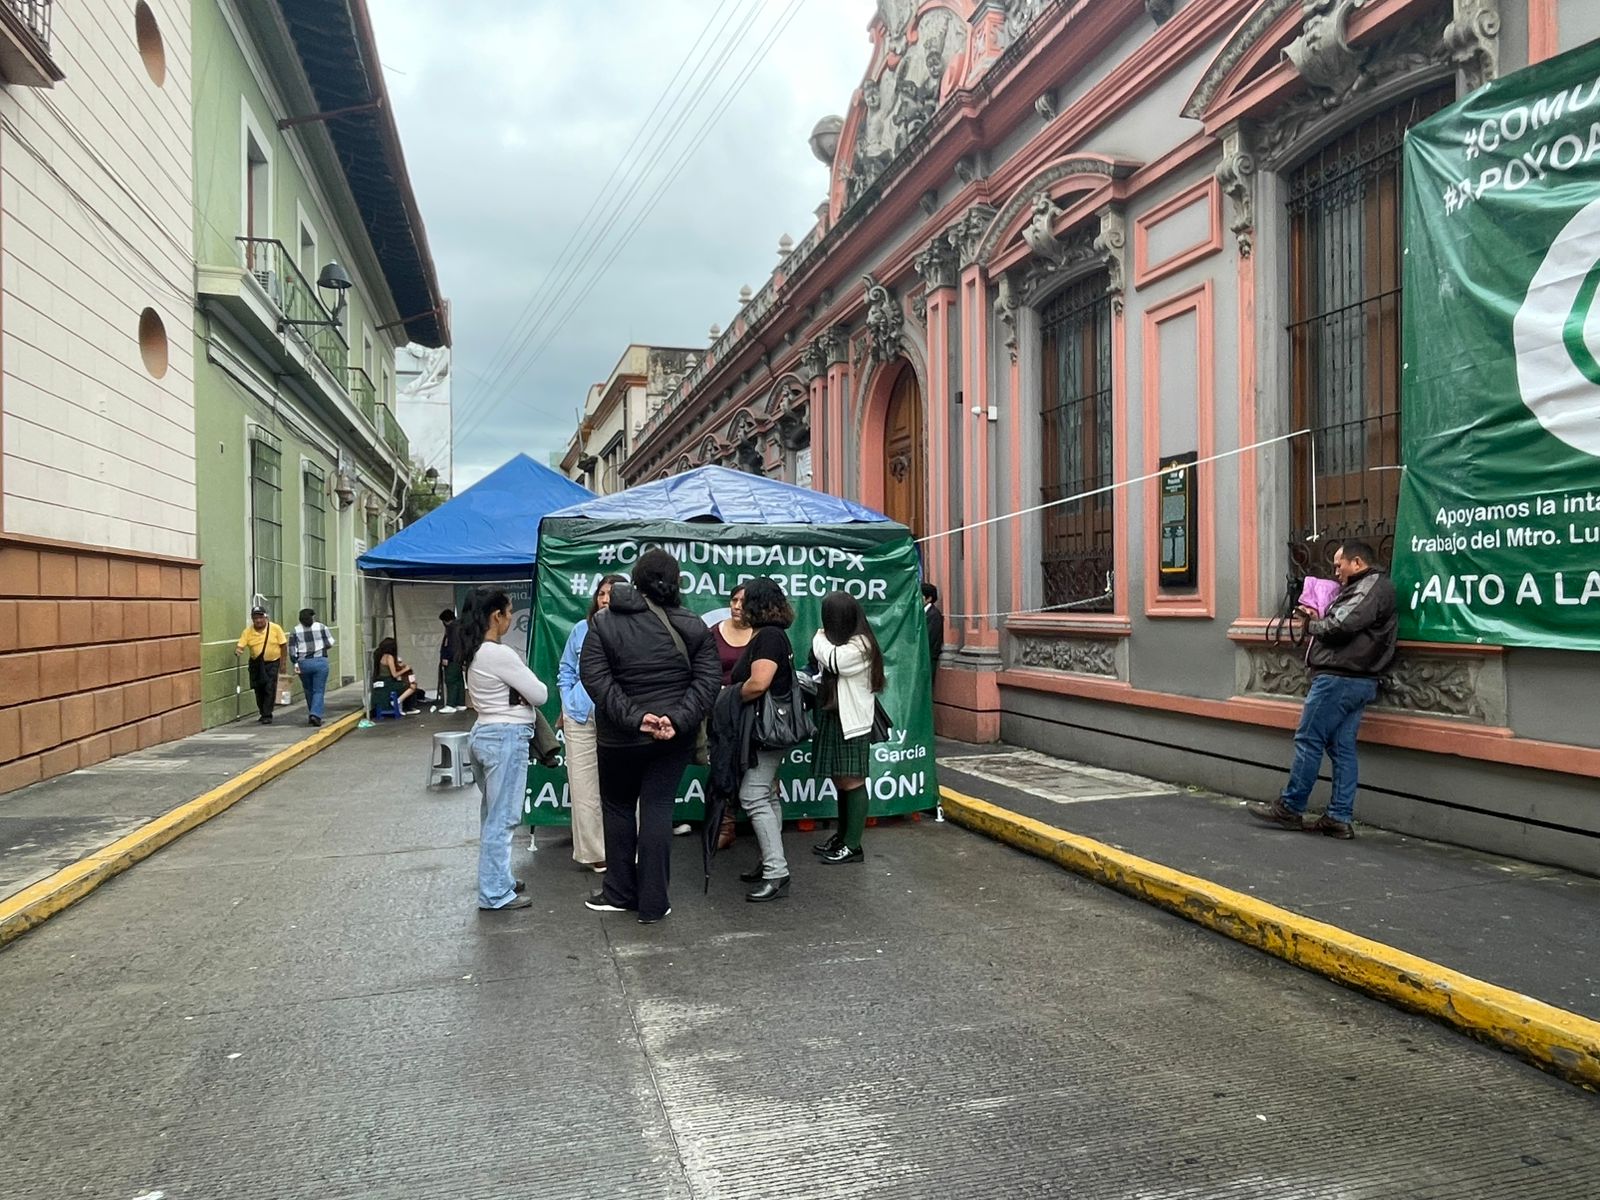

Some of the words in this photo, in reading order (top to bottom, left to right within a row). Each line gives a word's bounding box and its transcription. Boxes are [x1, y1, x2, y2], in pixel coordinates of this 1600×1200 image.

[1435, 503, 1530, 529] Apoyamos
[1536, 496, 1556, 516] la
[1411, 532, 1467, 555] trabajo
[1470, 528, 1500, 550] del
[1506, 527, 1562, 547] Mtro.
[1410, 573, 1505, 610] ¡ALTO
[1515, 572, 1543, 606] A
[1554, 570, 1600, 606] LA
[874, 744, 927, 763] García
[524, 781, 573, 814] ¡AL
